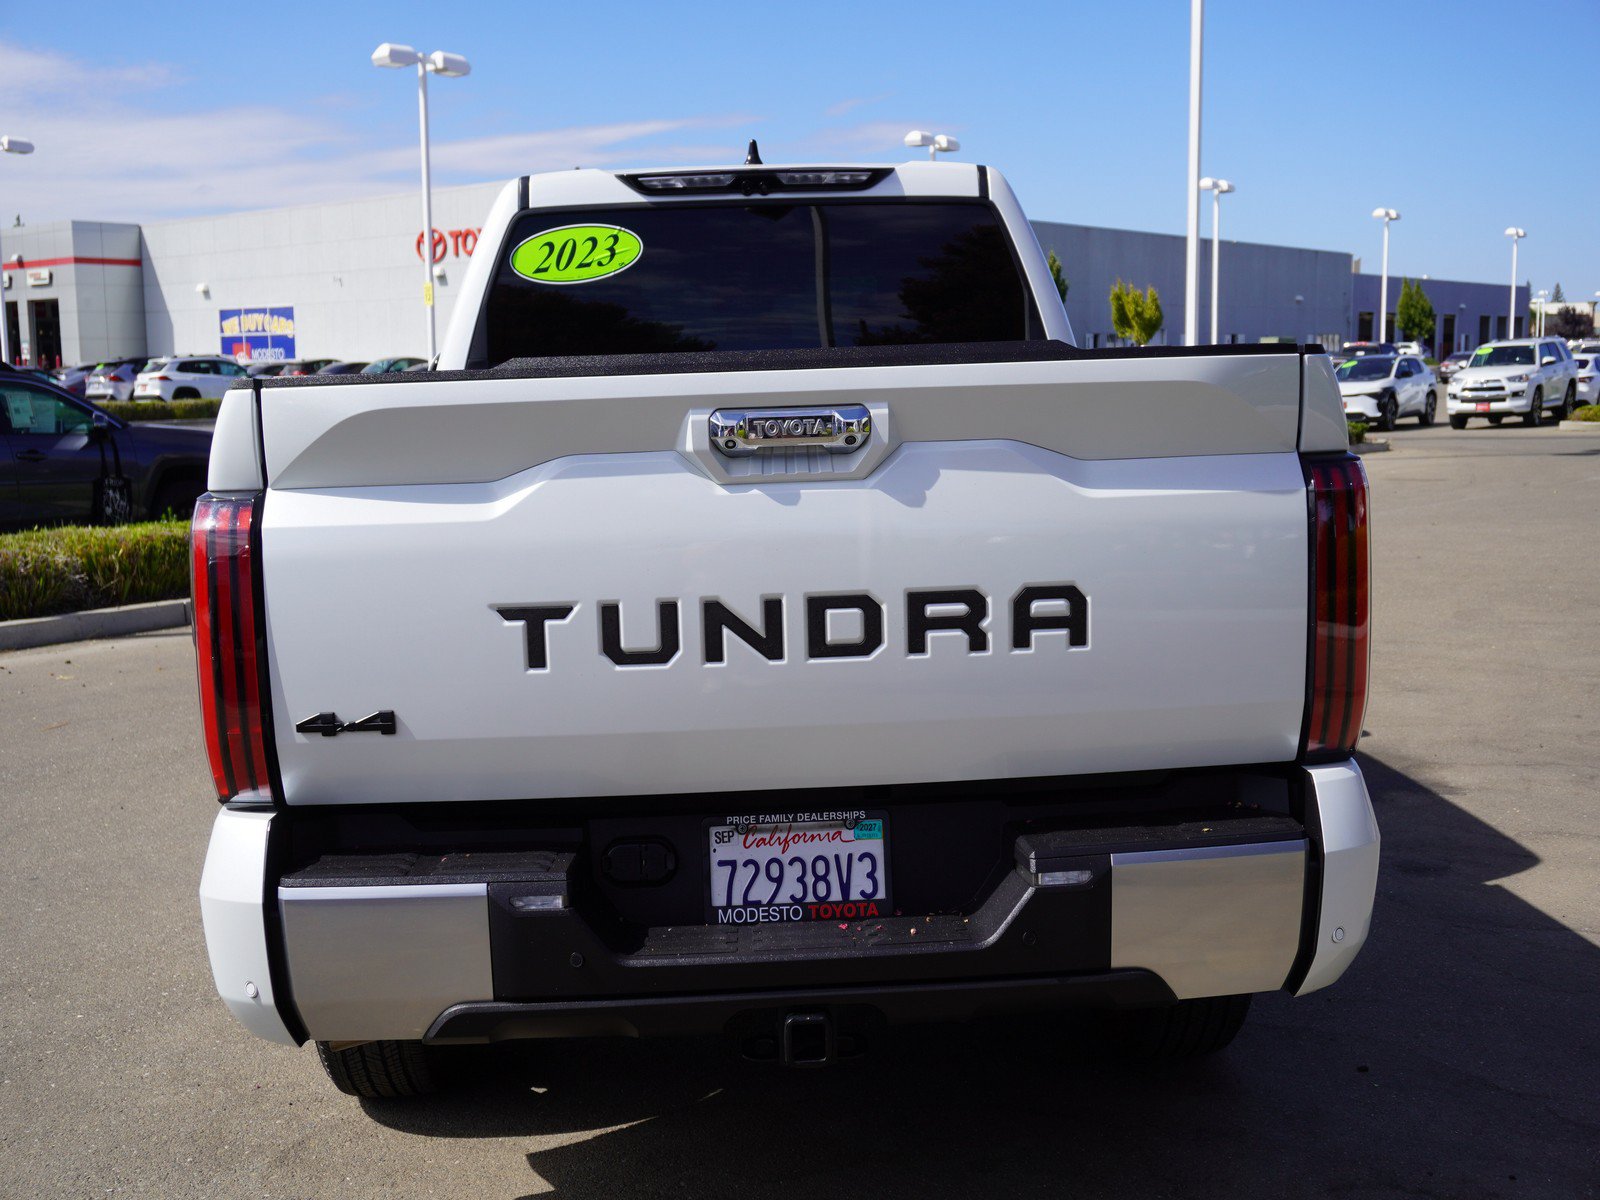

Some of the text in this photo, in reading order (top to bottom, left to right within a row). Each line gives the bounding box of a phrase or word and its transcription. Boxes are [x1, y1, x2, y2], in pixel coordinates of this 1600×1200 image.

[448, 228, 482, 257] TO
[532, 233, 619, 275] 2023
[240, 313, 264, 332] BUY
[753, 419, 826, 438] TOYOTA
[491, 583, 1092, 673] TUNDRA
[726, 810, 866, 825] PRICE FAMILY DEALERSHIPS
[859, 823, 877, 832] 2027
[714, 830, 735, 844] SEP
[742, 825, 855, 854] California
[717, 852, 879, 906] 72938V3
[718, 902, 879, 924] MODESTO TOYOTA
